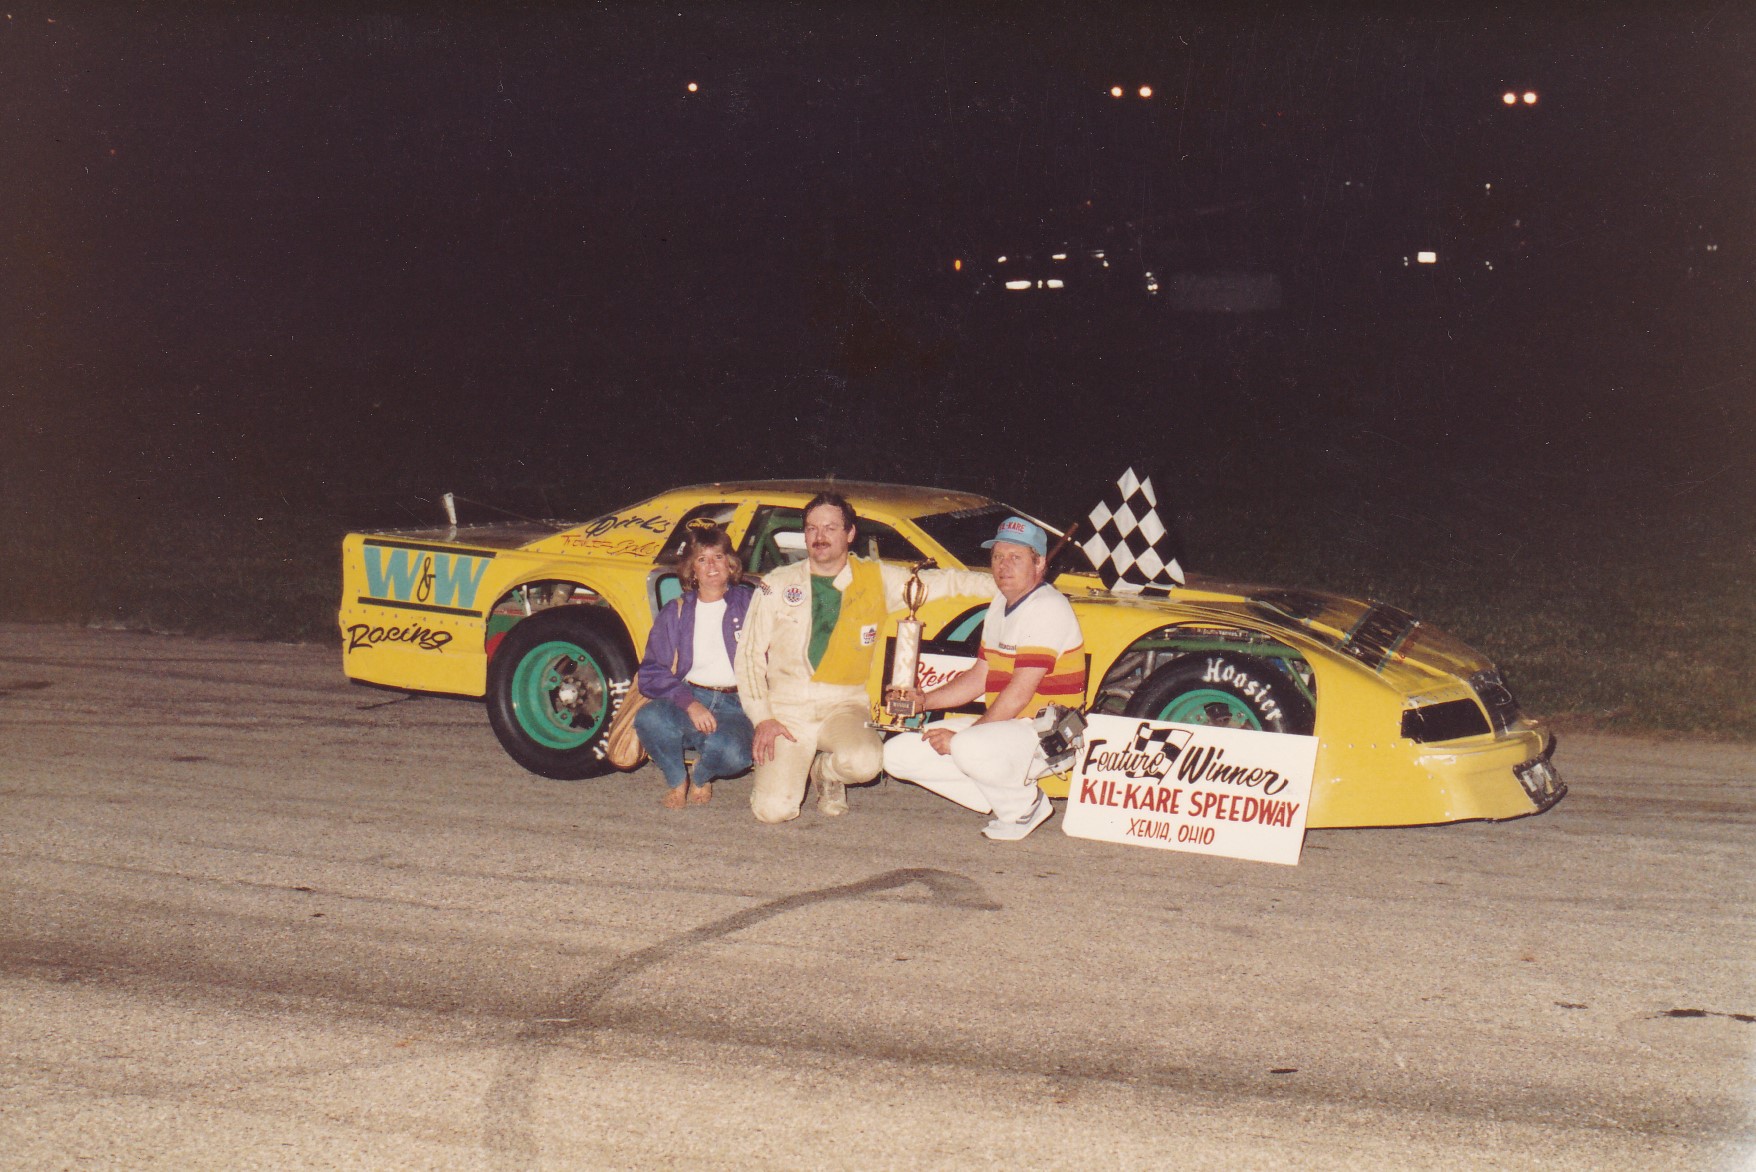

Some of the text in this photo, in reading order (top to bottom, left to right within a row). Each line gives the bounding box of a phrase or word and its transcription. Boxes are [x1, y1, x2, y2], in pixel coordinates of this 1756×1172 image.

[347, 623, 453, 654] Racing
[1202, 657, 1283, 721] Hoosier
[1081, 739, 1289, 796] Feature Winner
[1080, 778, 1300, 828] KIL-KARE SPEEDWAY
[1125, 817, 1216, 846] XENIA, OHIO
